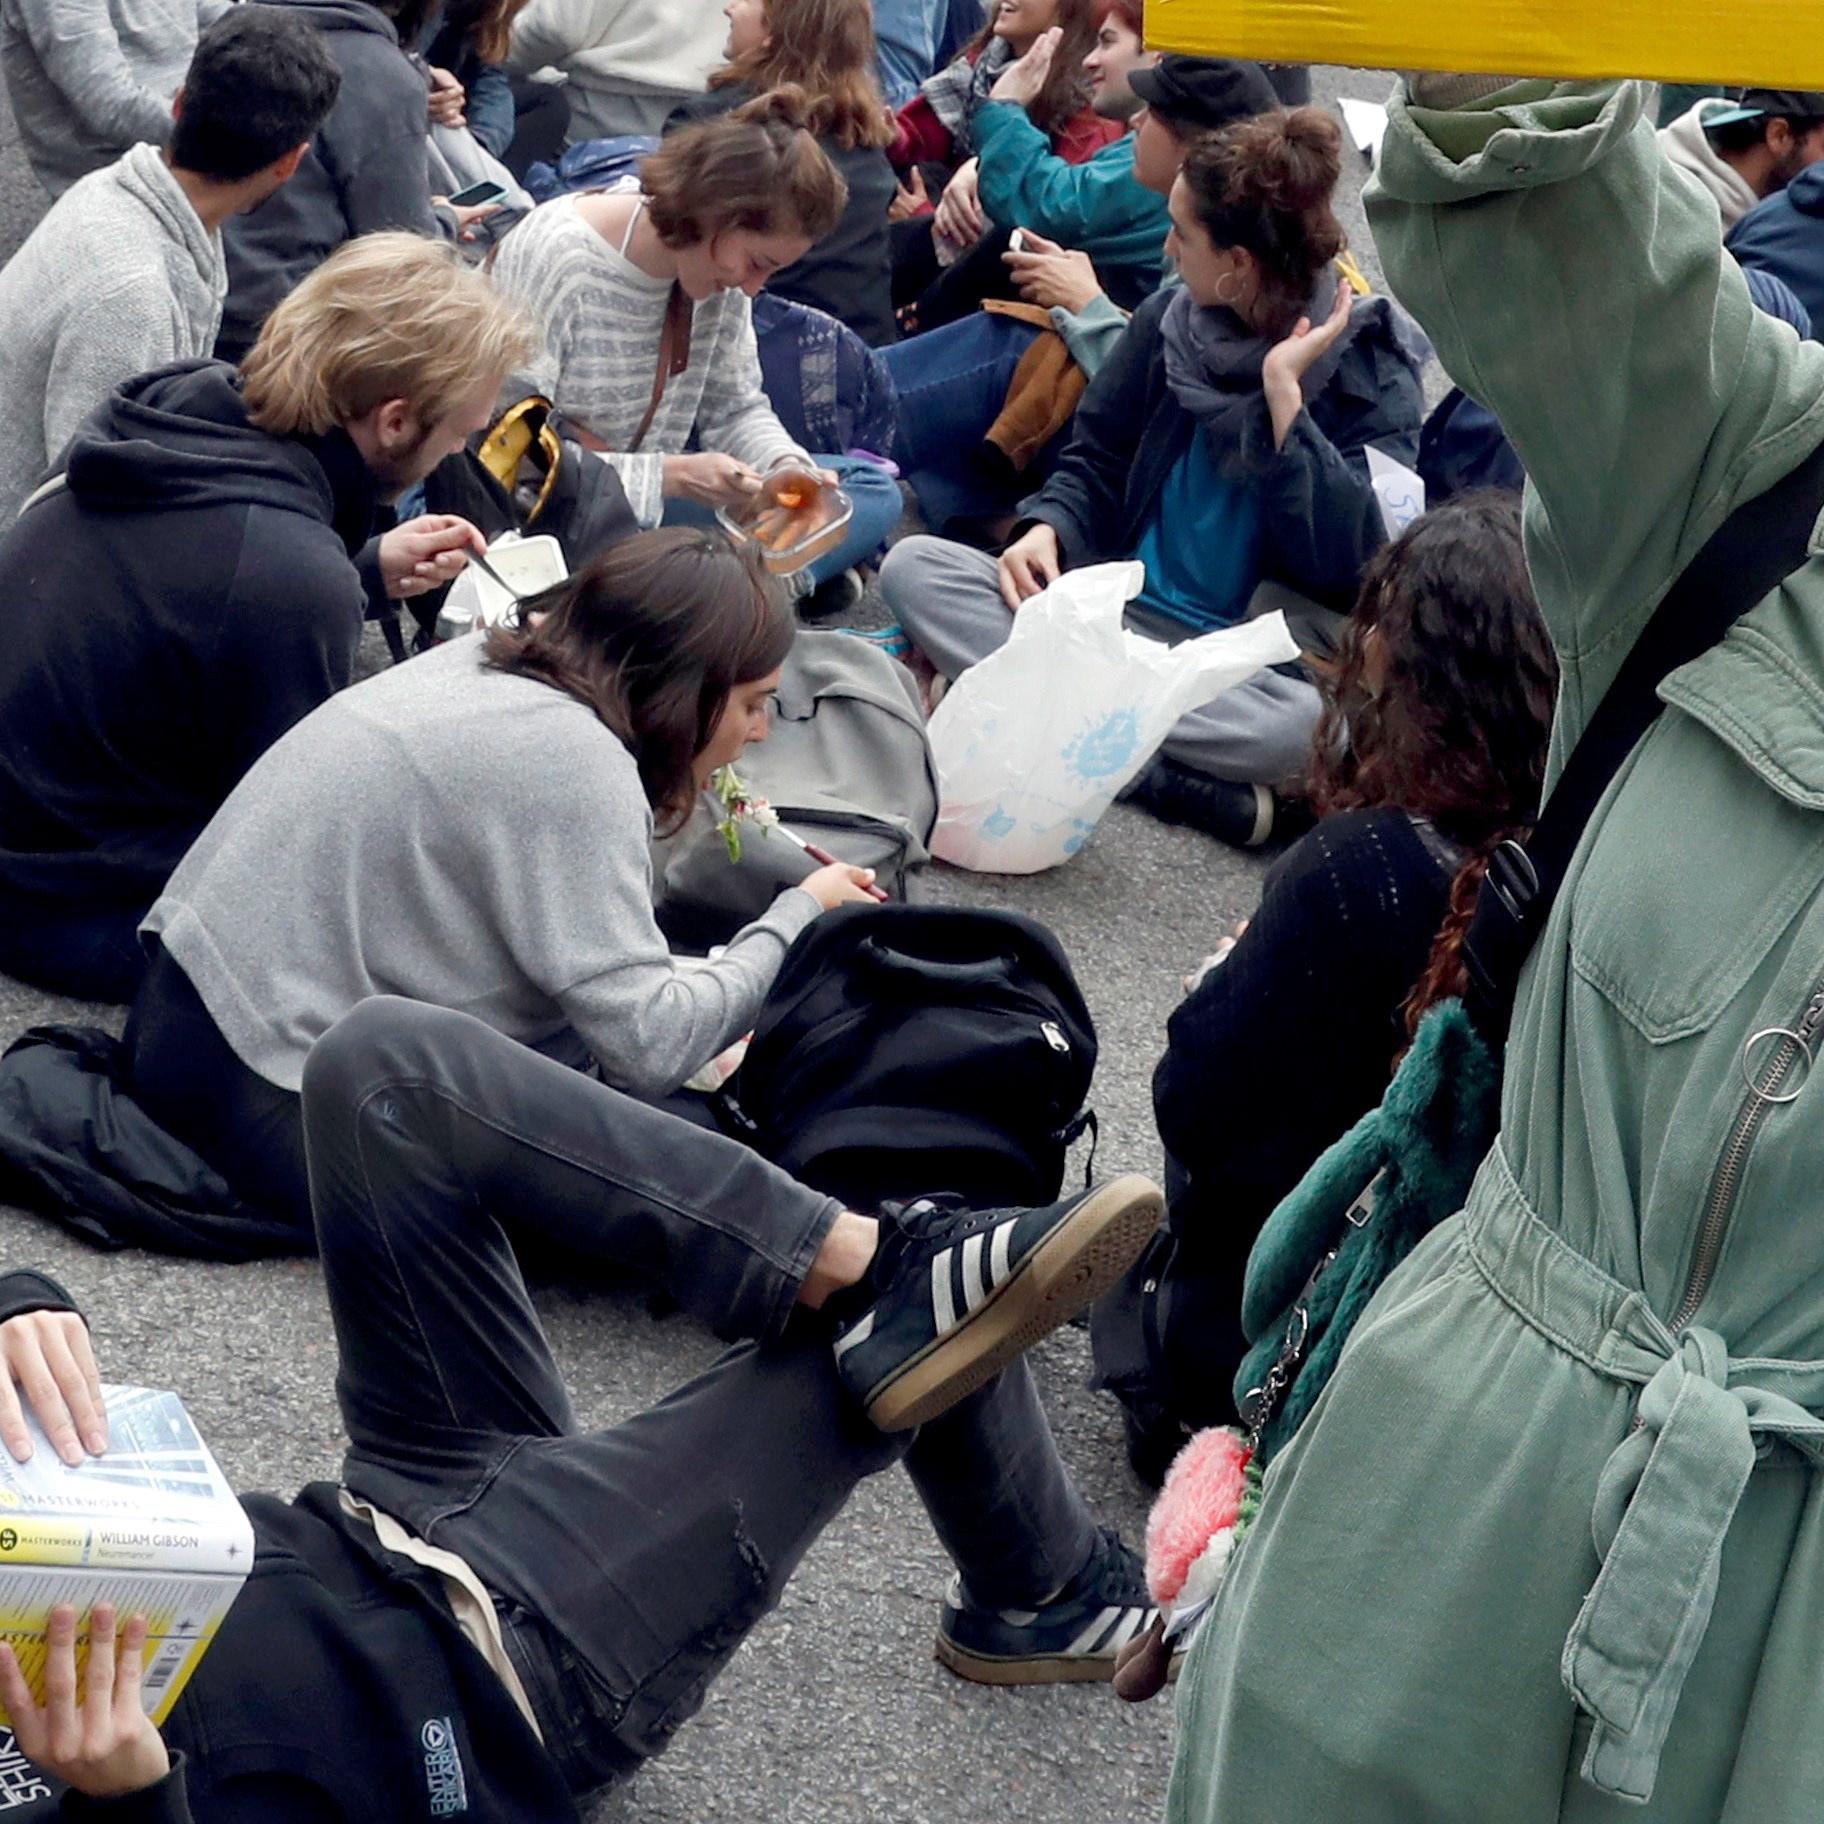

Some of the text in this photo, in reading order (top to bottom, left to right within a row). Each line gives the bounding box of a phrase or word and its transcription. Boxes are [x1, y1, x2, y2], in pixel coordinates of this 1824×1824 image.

[20, 1536, 83, 1548] MASTERWORKS
[100, 1531, 199, 1548] WILLIAM GIBSON
